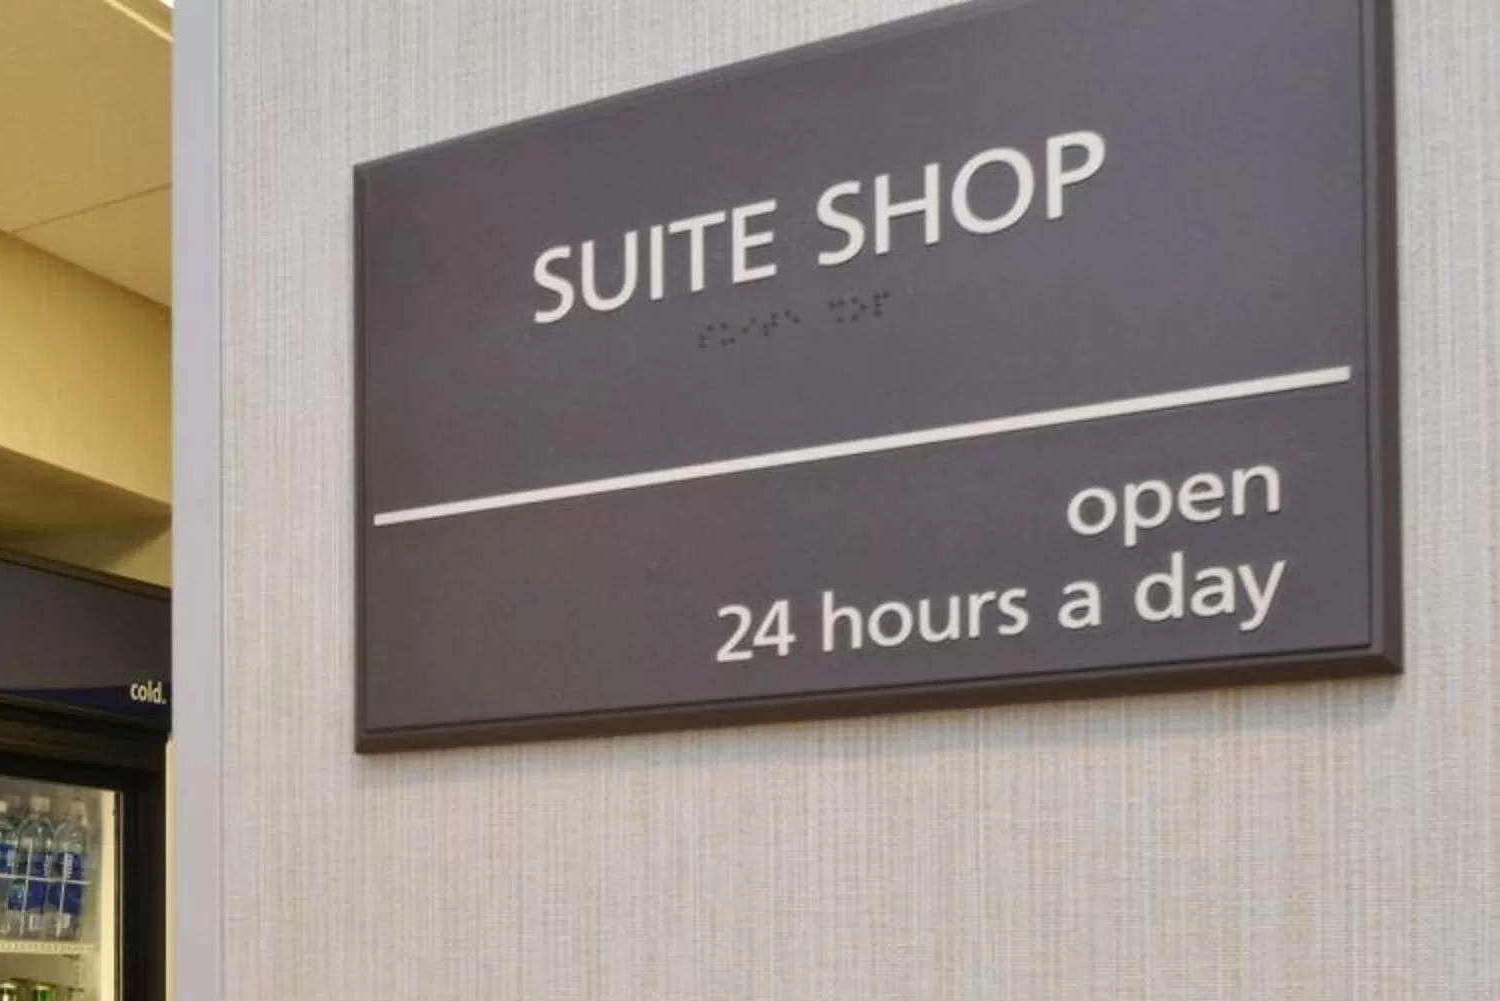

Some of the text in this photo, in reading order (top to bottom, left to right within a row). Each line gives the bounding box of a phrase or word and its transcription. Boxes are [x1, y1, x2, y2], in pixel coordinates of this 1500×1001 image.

[532, 199, 779, 325] SUITE
[815, 130, 1107, 268] SHOP
[1065, 463, 1282, 547] open
[715, 550, 1287, 663] 24 hours a day
[130, 679, 168, 705] cold.
